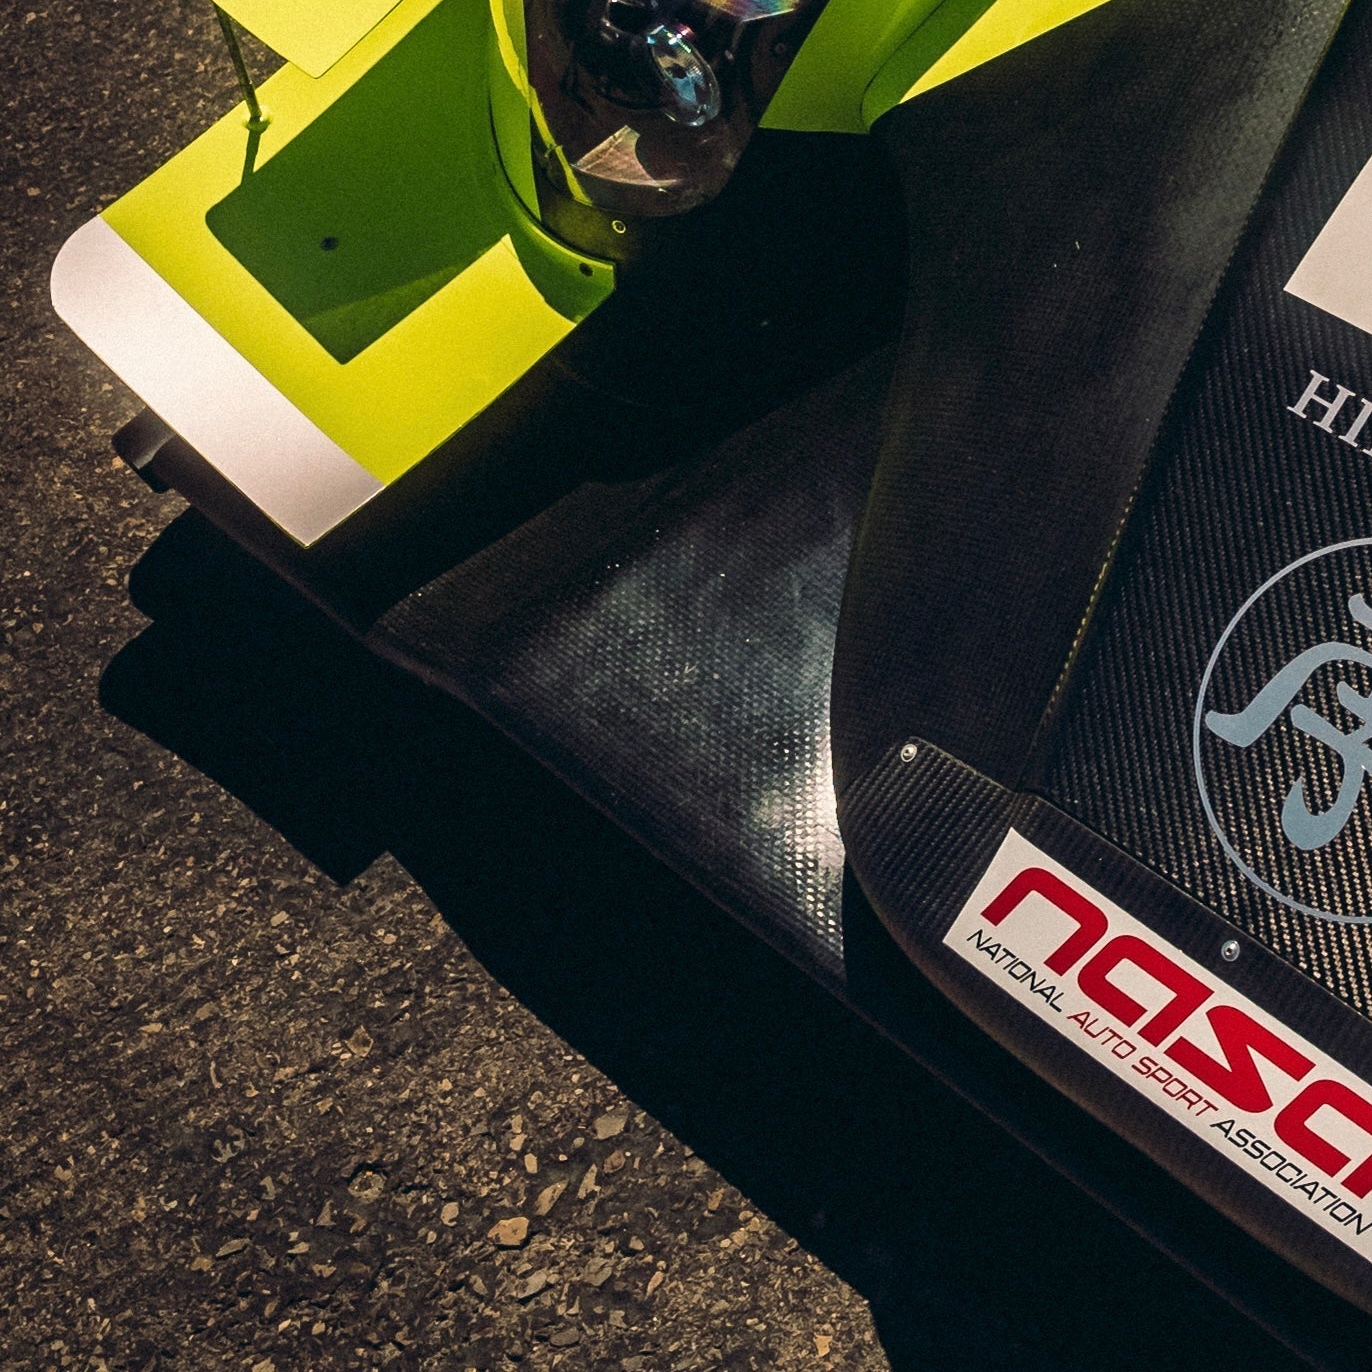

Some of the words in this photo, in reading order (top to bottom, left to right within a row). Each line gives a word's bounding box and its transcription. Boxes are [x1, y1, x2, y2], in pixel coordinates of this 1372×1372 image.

[966, 929, 1064, 1013] NATIONAL
[1067, 1011, 1137, 1060] AUTO
[1132, 1057, 1219, 1117] SPORT
